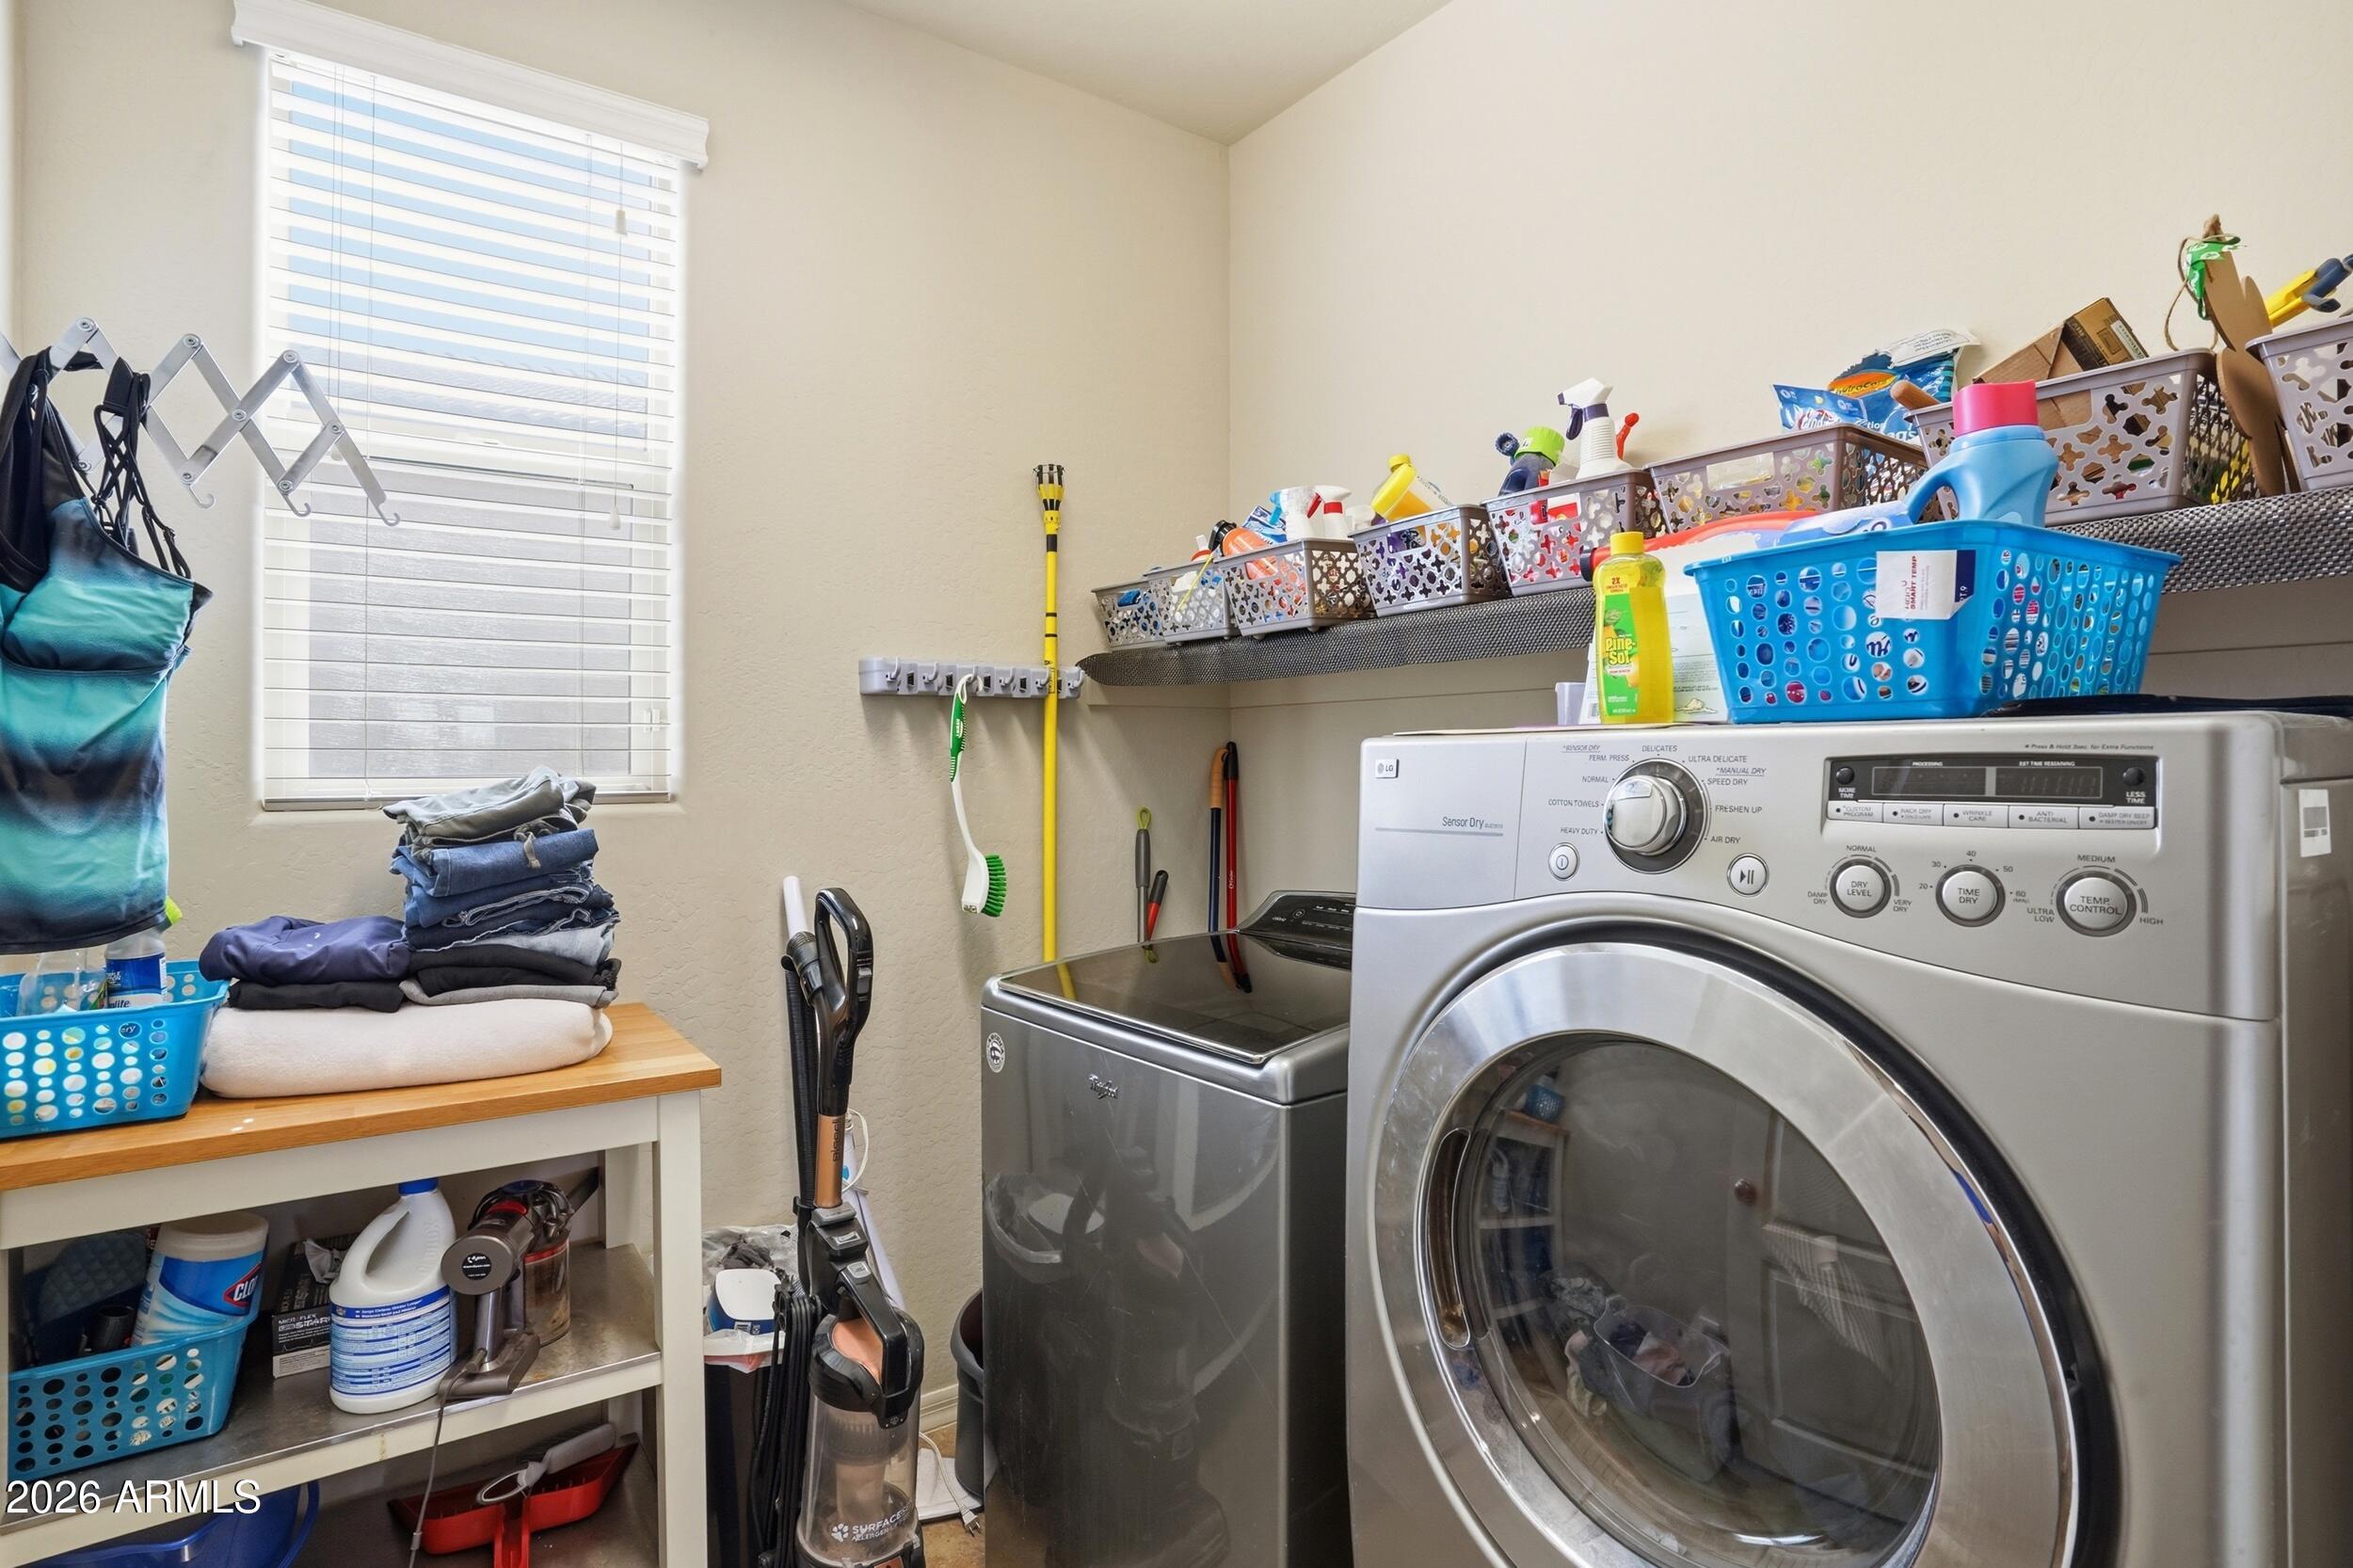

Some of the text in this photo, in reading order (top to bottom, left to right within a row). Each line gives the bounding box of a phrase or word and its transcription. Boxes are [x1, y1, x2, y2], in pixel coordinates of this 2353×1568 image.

[1609, 649, 1631, 665] Sol
[1641, 744, 1678, 753] DELICATES
[1589, 754, 1608, 762] PERM.
[1689, 755, 1748, 763] ULTRA DELICATE
[1385, 764, 1394, 773] LG
[1751, 767, 1767, 776] DRY
[1707, 777, 1731, 786] SPEED
[1715, 805, 1763, 814] FRESHEN UP
[1442, 816, 1468, 827] Sensor
[1469, 817, 1484, 829] Dry
[1561, 826, 1598, 836] HEAVY DUTY
[1710, 835, 1741, 844] AIR DRY
[1846, 844, 1877, 853] NORMAL
[2077, 854, 2116, 863] MEDIUM
[2003, 865, 2014, 873] 50
[1850, 880, 1868, 888] DRY
[1847, 888, 1872, 897] LEVEL
[1958, 888, 1981, 897] TIME
[1959, 896, 1978, 904] DRY
[2026, 907, 2056, 916] ULTRA
[2070, 904, 2123, 916] CONTROL
[2034, 915, 2056, 923] LOW
[2139, 917, 2164, 926] HIGH
